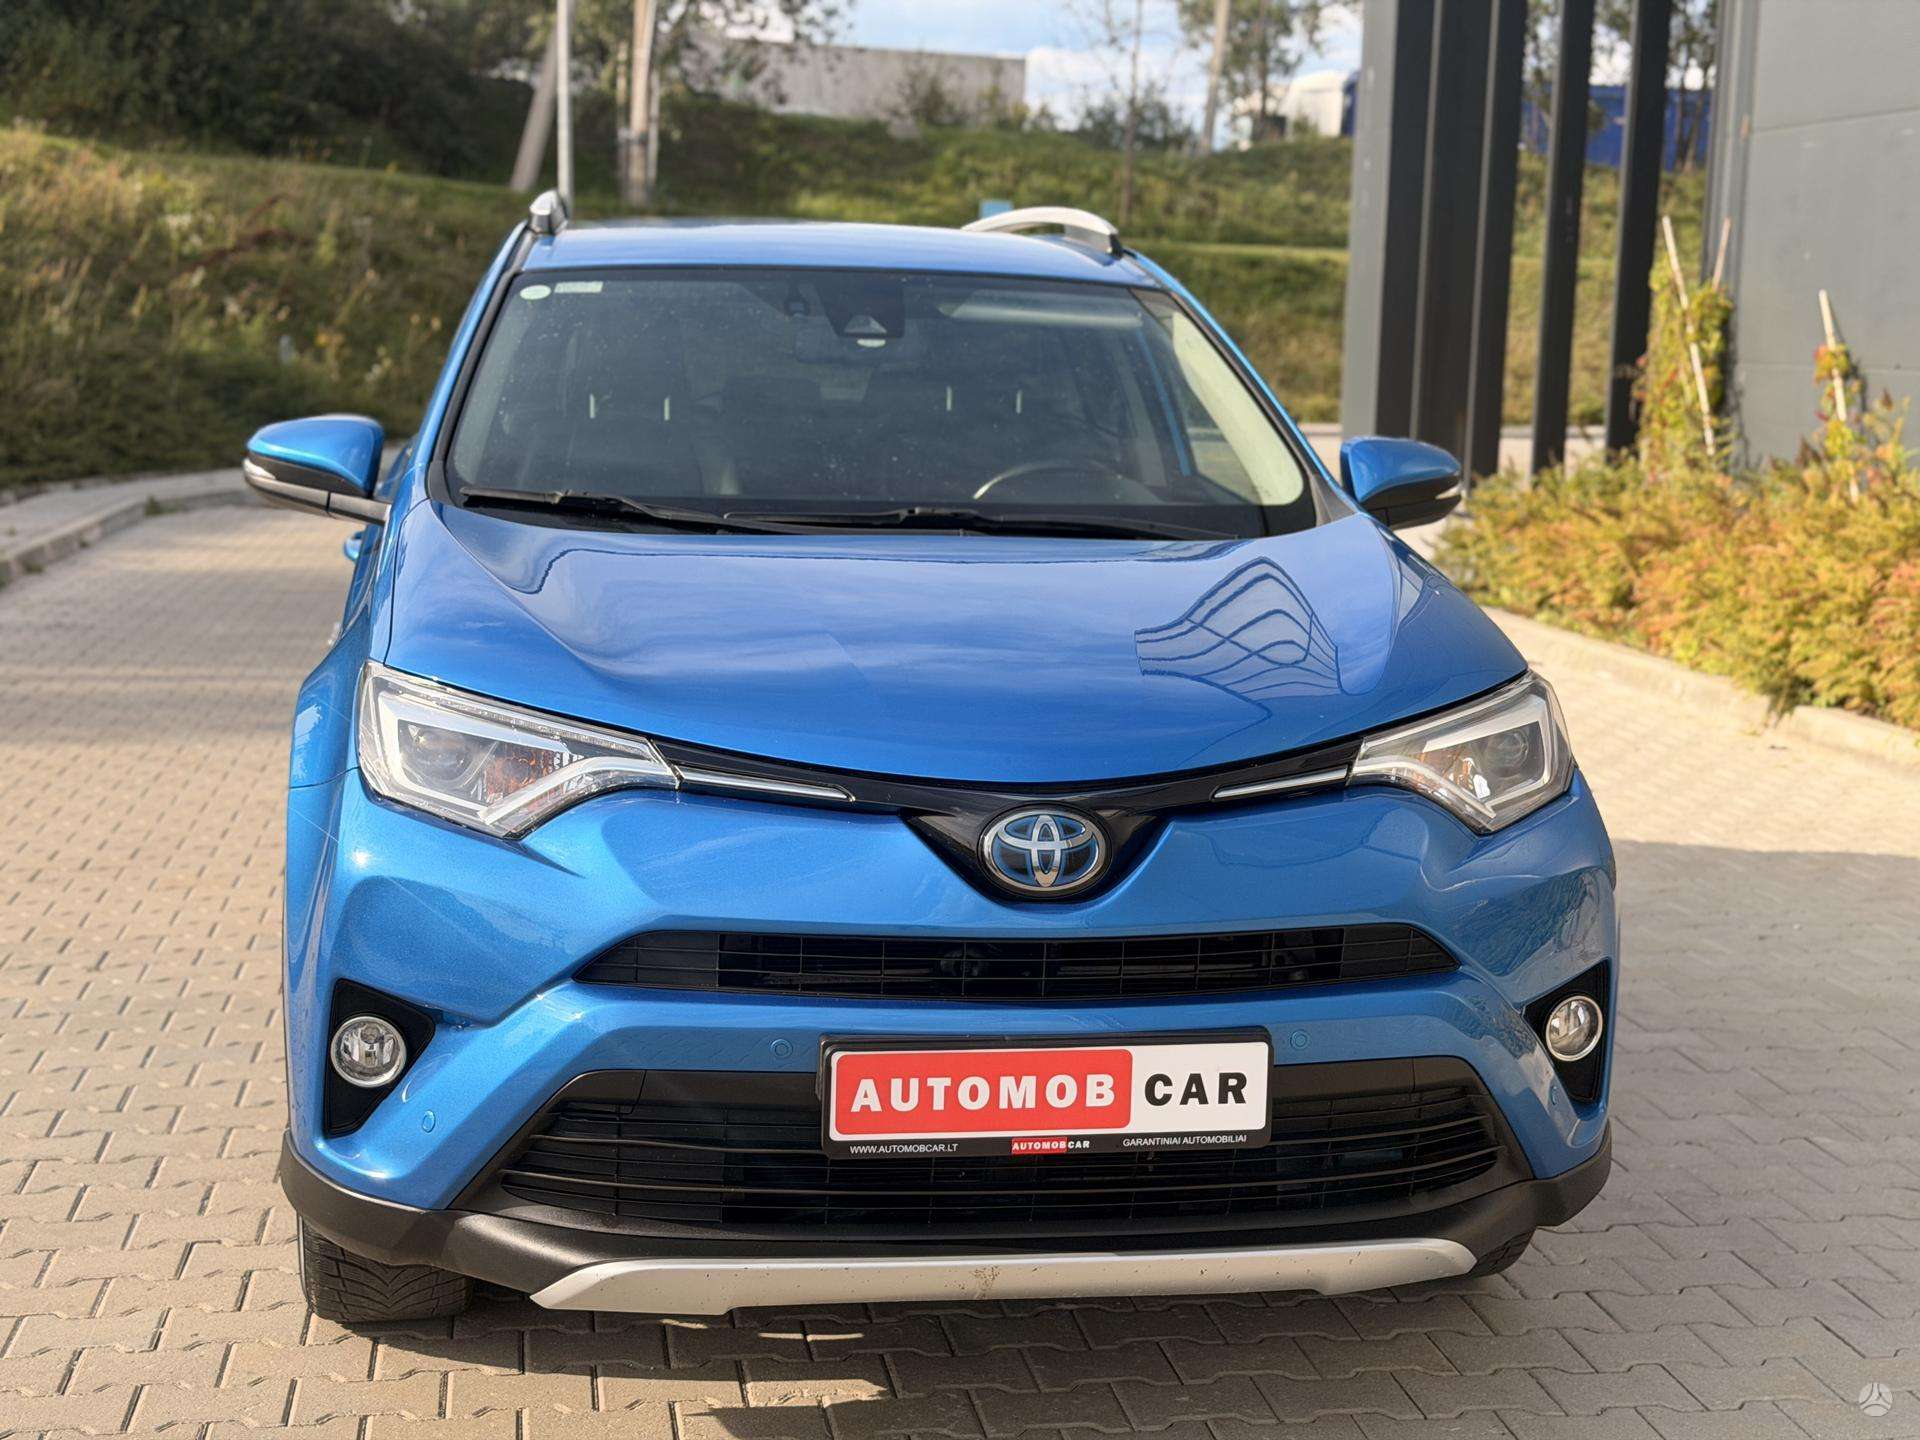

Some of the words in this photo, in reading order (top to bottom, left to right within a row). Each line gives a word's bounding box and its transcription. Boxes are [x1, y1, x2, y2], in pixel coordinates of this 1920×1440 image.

[850, 1073, 1116, 1113] AUTOMOB
[1144, 1072, 1248, 1107] CAR
[1122, 1137, 1181, 1147] GARANTINIAI
[1182, 1134, 1248, 1145] AUTOMOBILIAI
[849, 1143, 959, 1155] WWW.AUTOMOBCAR.LT
